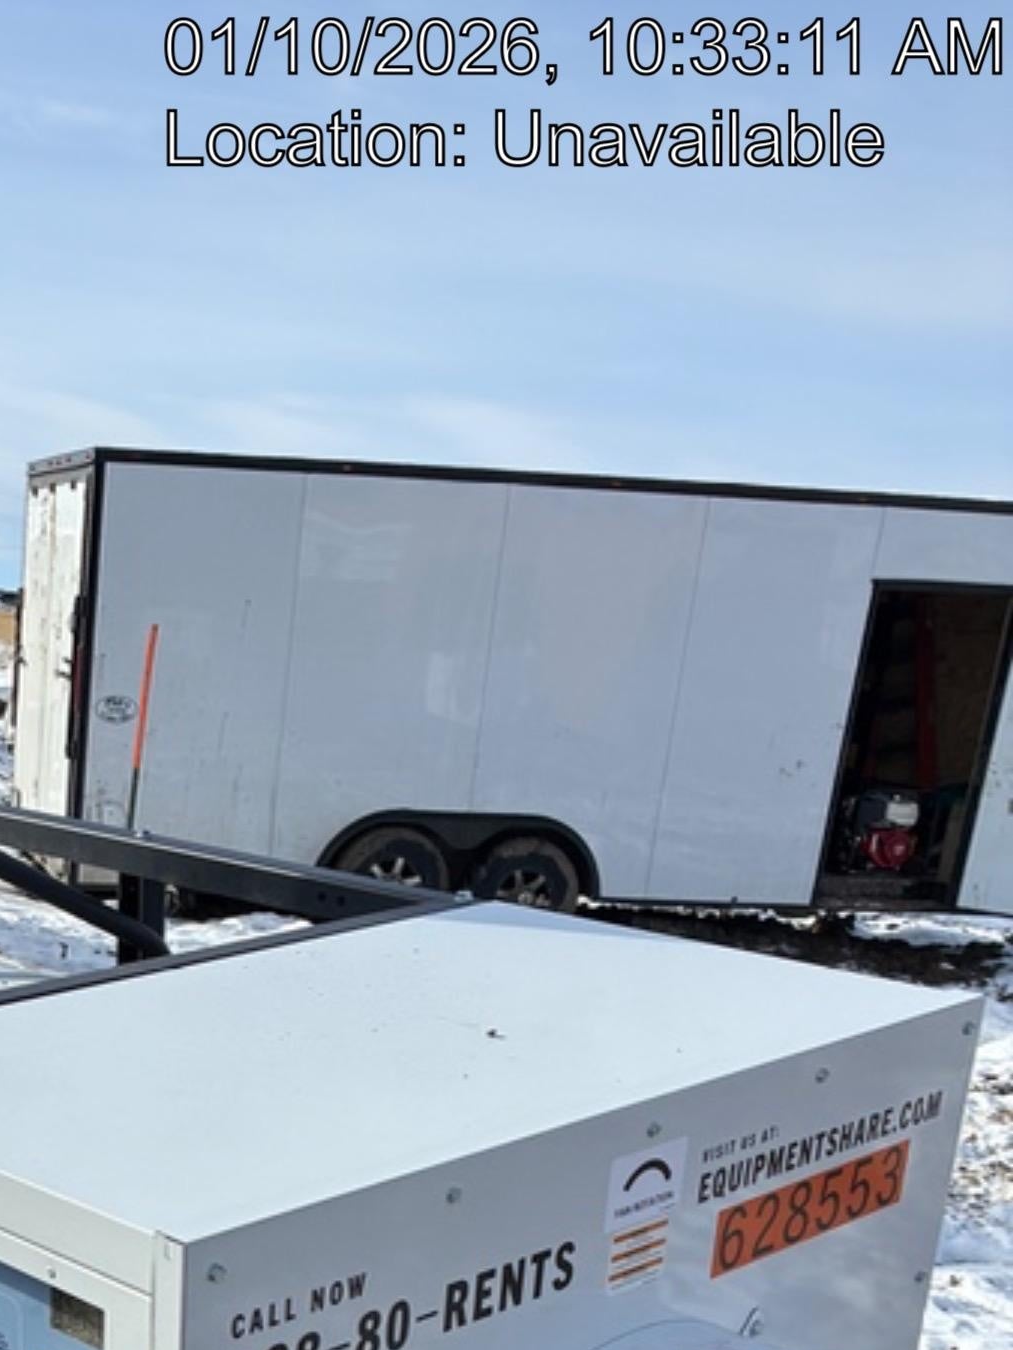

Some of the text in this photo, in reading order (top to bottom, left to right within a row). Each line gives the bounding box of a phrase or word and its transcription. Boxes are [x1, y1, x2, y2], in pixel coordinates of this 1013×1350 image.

[697, 1090, 943, 1203] EQUIPMENTSHARE.COM
[702, 1142, 736, 1163] VISIT
[740, 1133, 757, 1150] US
[718, 1147, 902, 1270] 628553
[231, 1272, 367, 1339] CALL NOW
